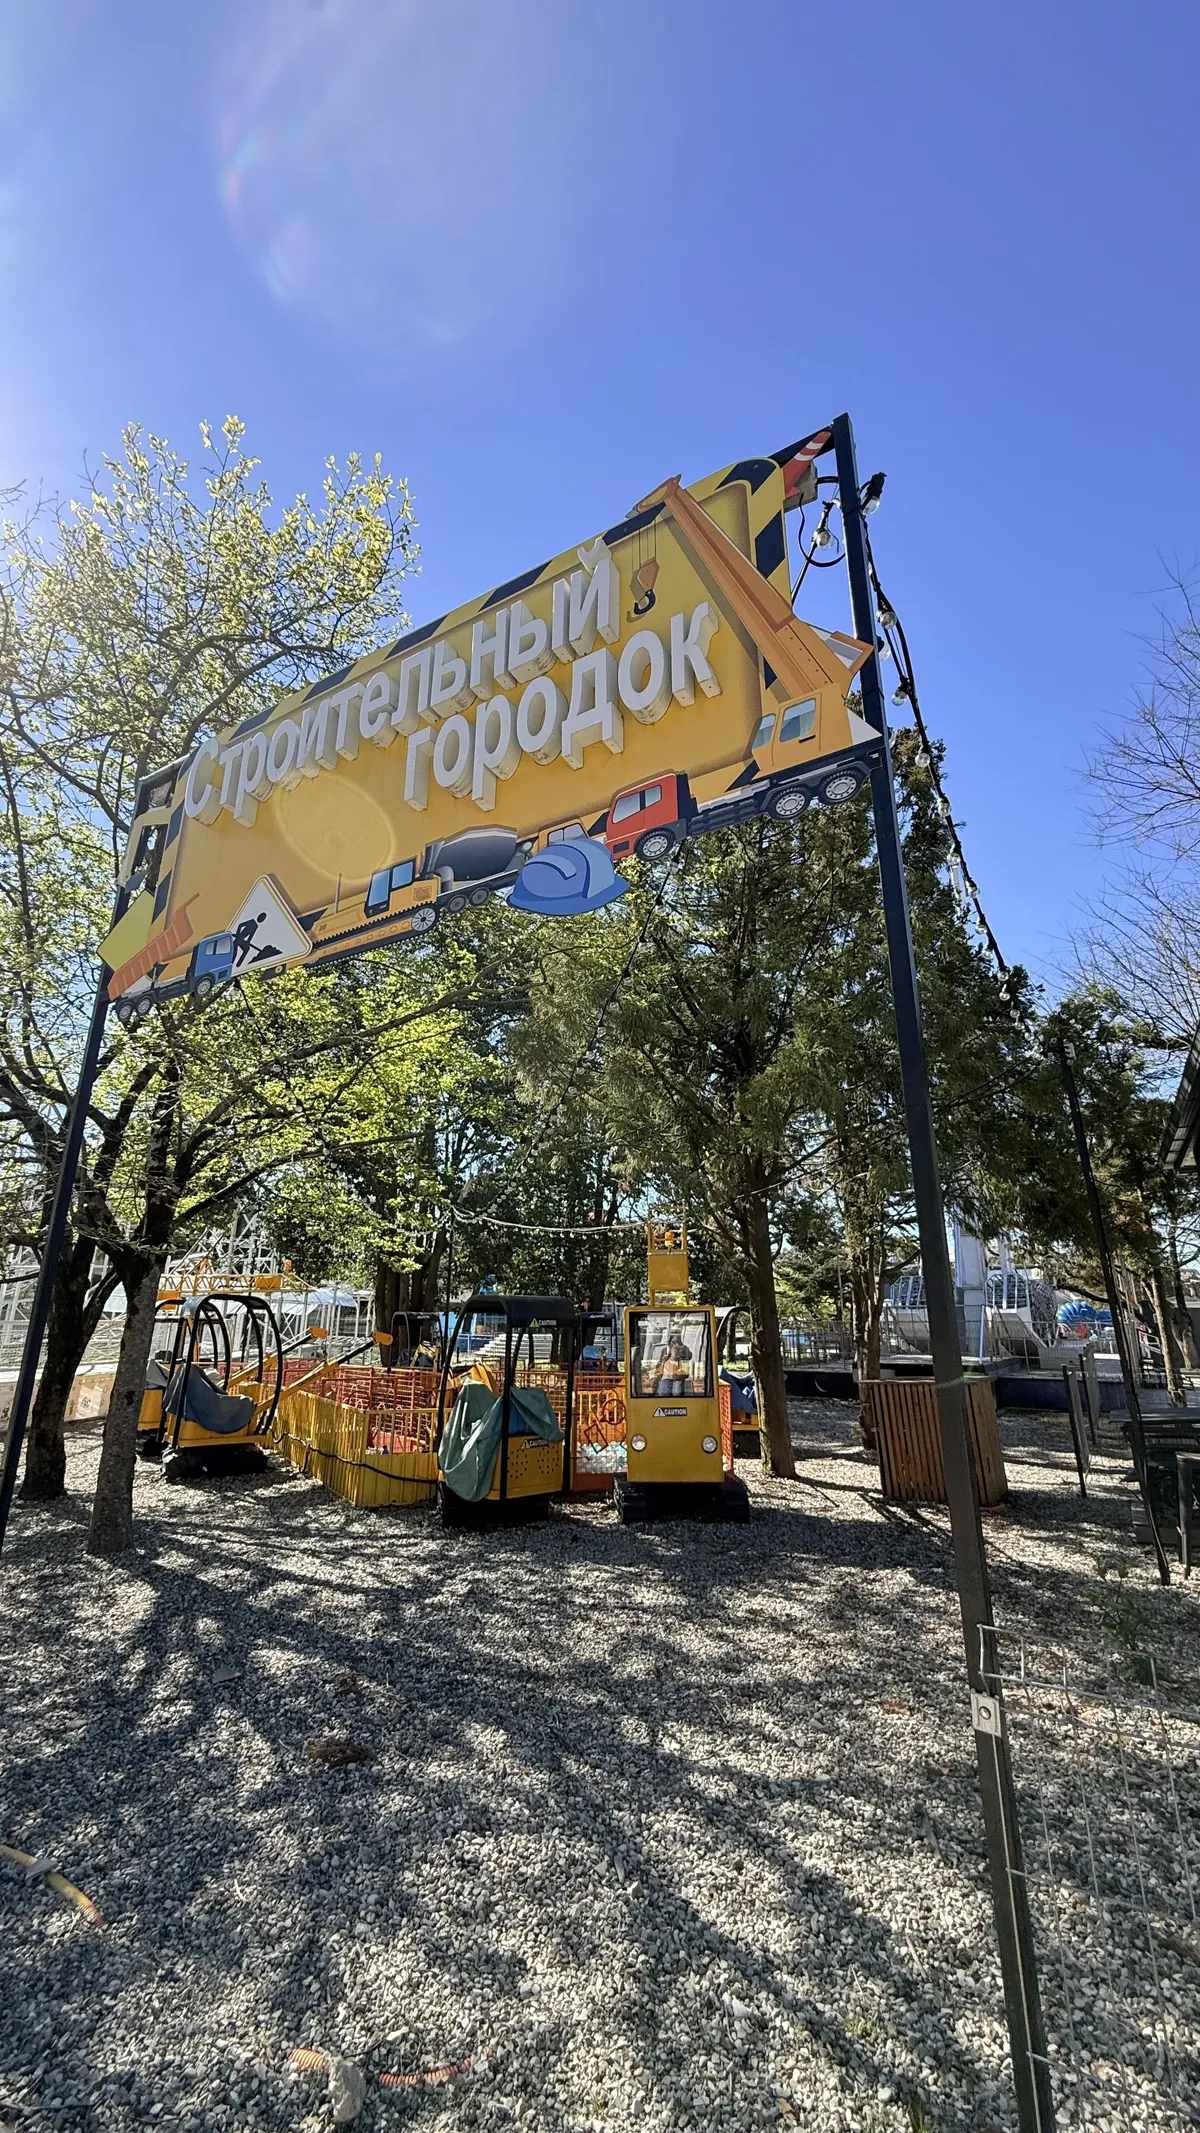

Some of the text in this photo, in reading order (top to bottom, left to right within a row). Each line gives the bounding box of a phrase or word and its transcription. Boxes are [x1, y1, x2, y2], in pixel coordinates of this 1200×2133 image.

[184, 537, 617, 826] Строительный
[404, 601, 720, 810] городок
[664, 1408, 687, 1416] CAUTION
